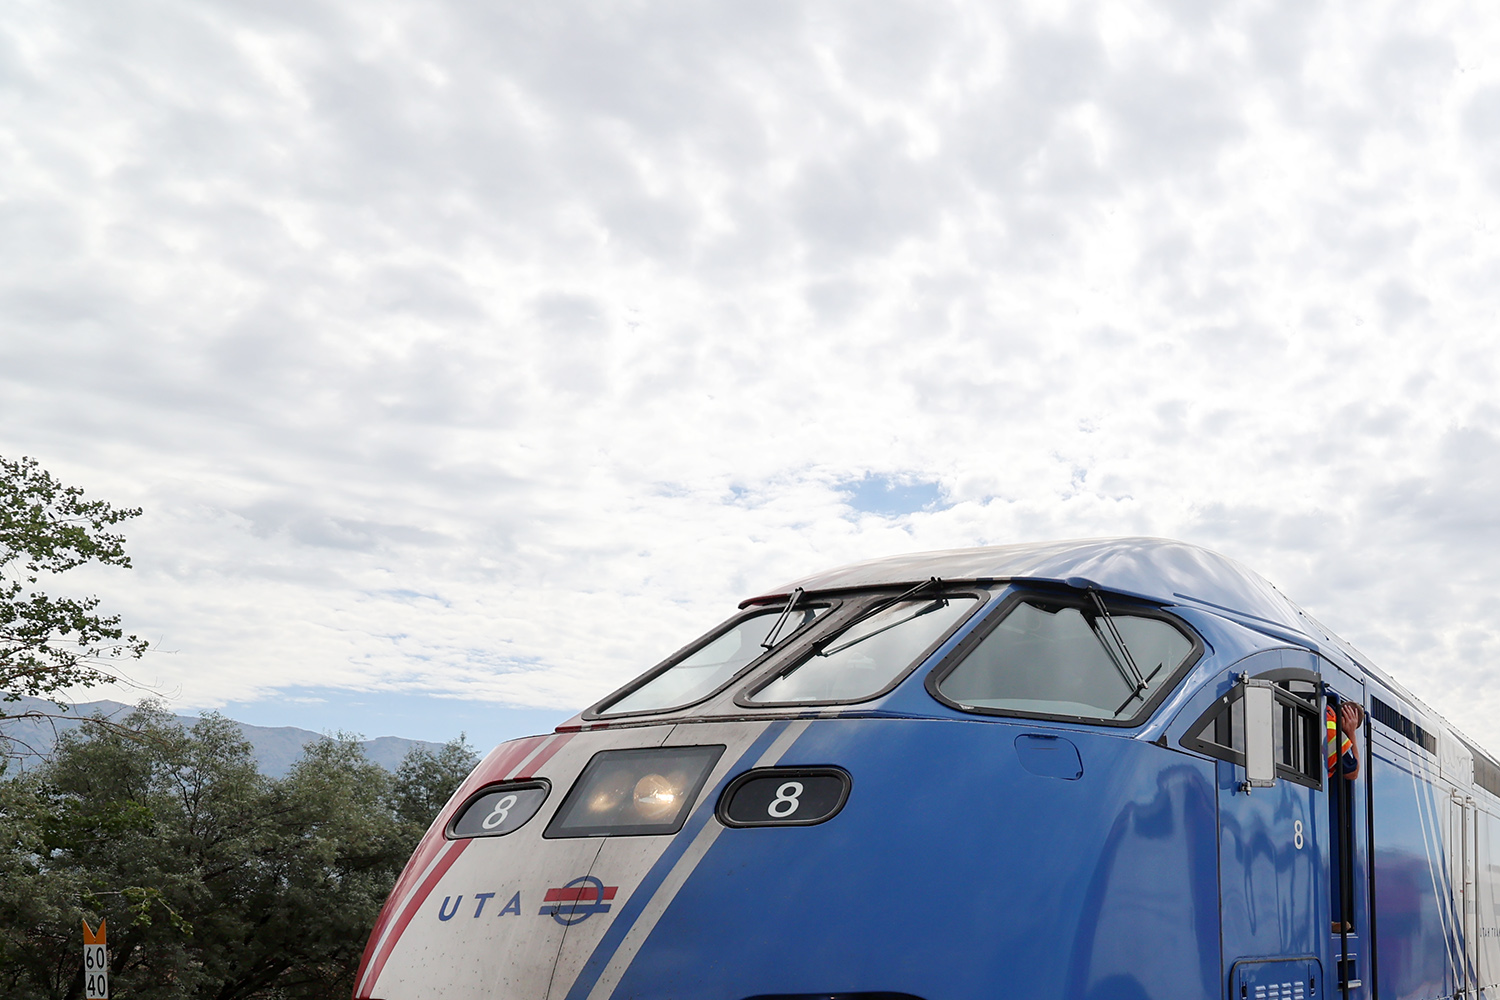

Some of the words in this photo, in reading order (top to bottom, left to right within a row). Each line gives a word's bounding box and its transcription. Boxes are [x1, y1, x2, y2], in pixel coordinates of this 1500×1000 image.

[481, 795, 518, 830] 8
[767, 781, 804, 818] 8
[1294, 819, 1304, 850] 8
[438, 891, 522, 922] UTA
[86, 946, 105, 970] 60
[87, 974, 106, 997] 40
